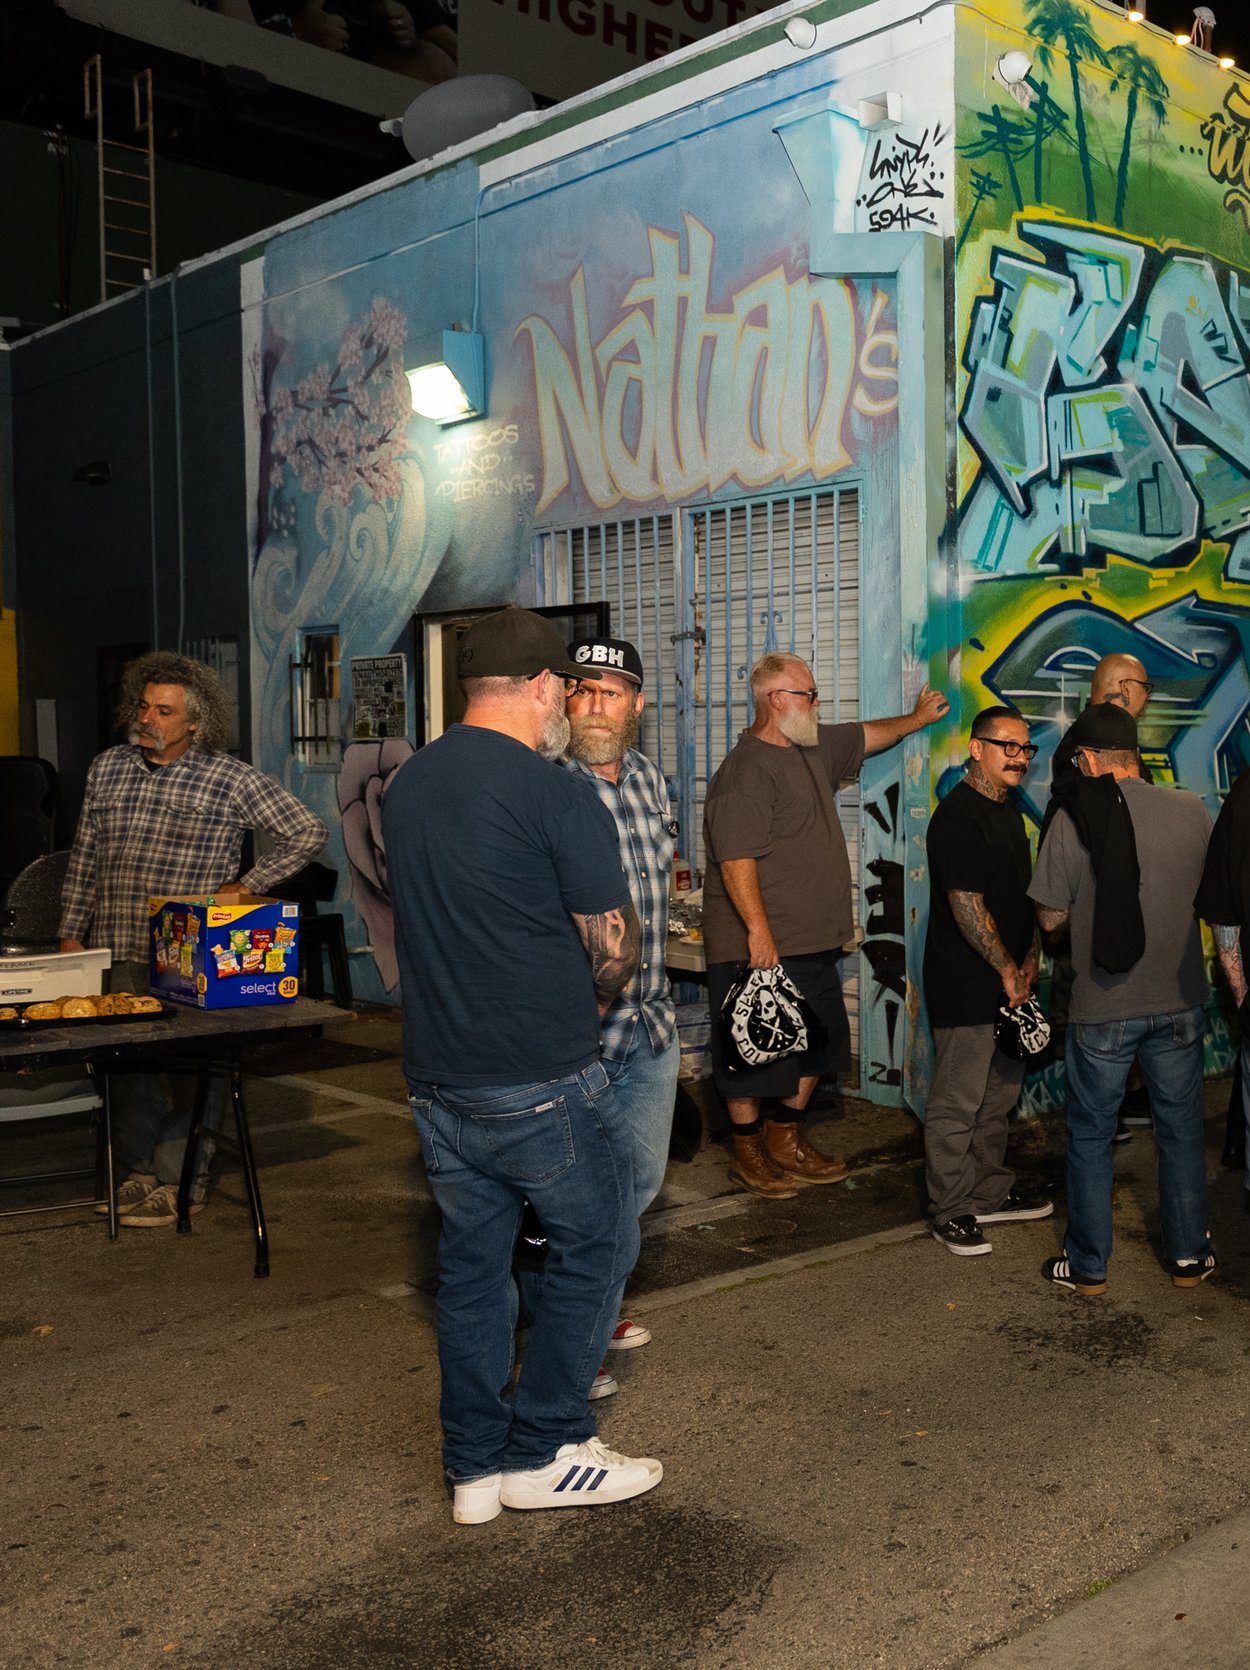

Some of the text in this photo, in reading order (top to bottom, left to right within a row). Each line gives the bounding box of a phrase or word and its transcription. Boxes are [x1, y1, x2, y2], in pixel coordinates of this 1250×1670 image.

[494, 0, 698, 61] IGHE
[511, 211, 898, 516] Nathan's
[575, 645, 625, 668] GBH
[240, 980, 295, 994] select 30
